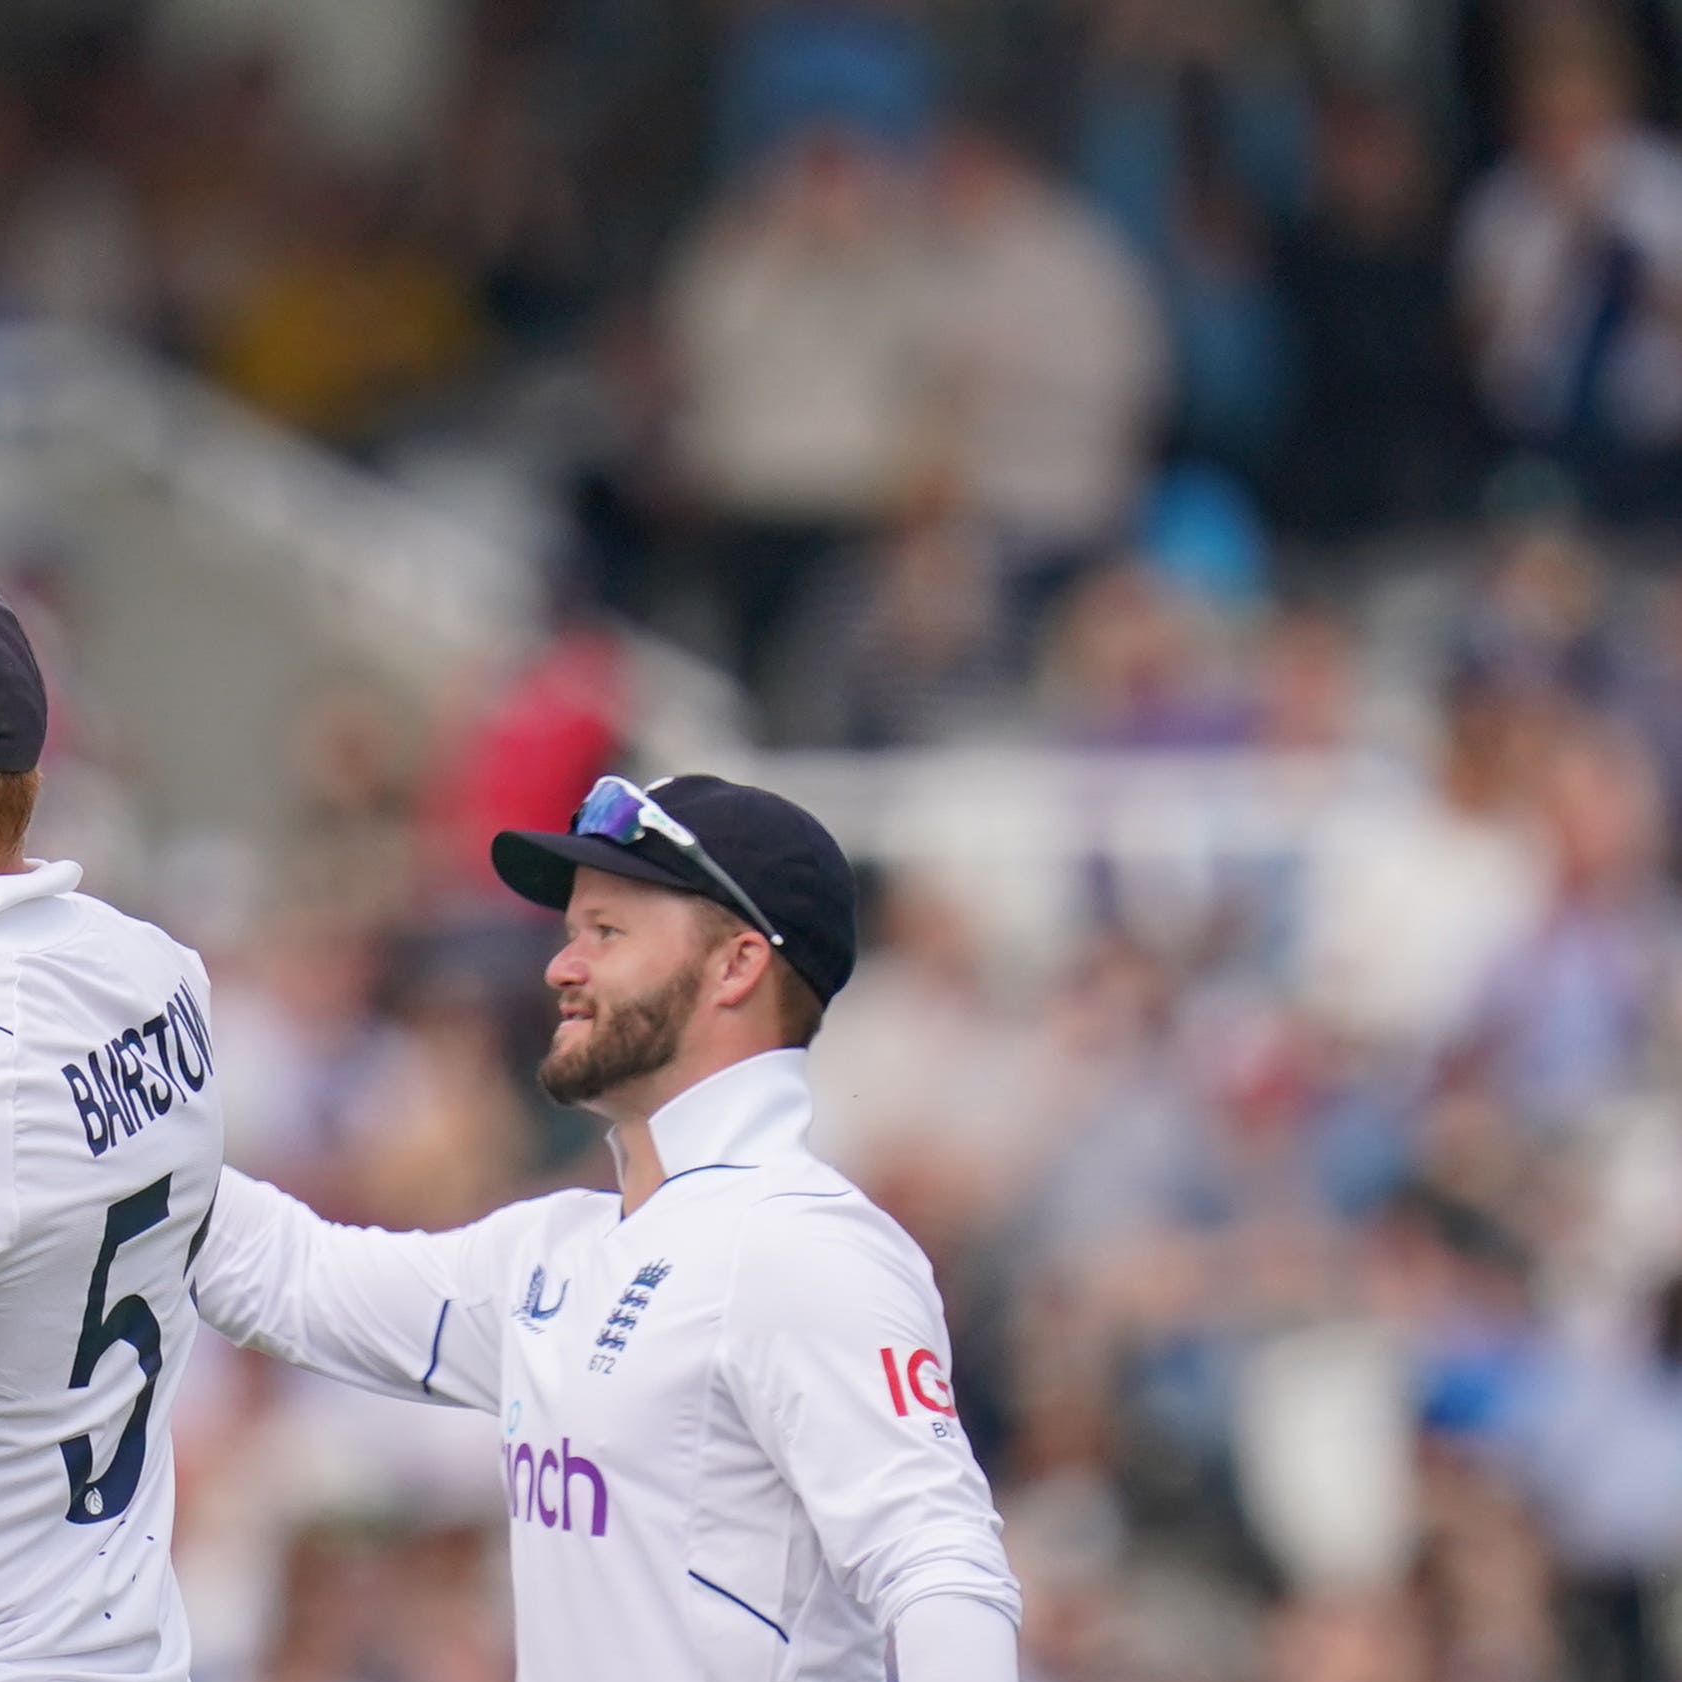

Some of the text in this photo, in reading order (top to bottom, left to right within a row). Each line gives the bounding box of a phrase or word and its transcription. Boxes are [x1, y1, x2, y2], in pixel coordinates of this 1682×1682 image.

[61, 976, 214, 1158] BAIRSTOW
[58, 1172, 163, 1525] 5
[880, 1347, 957, 1418] IG
